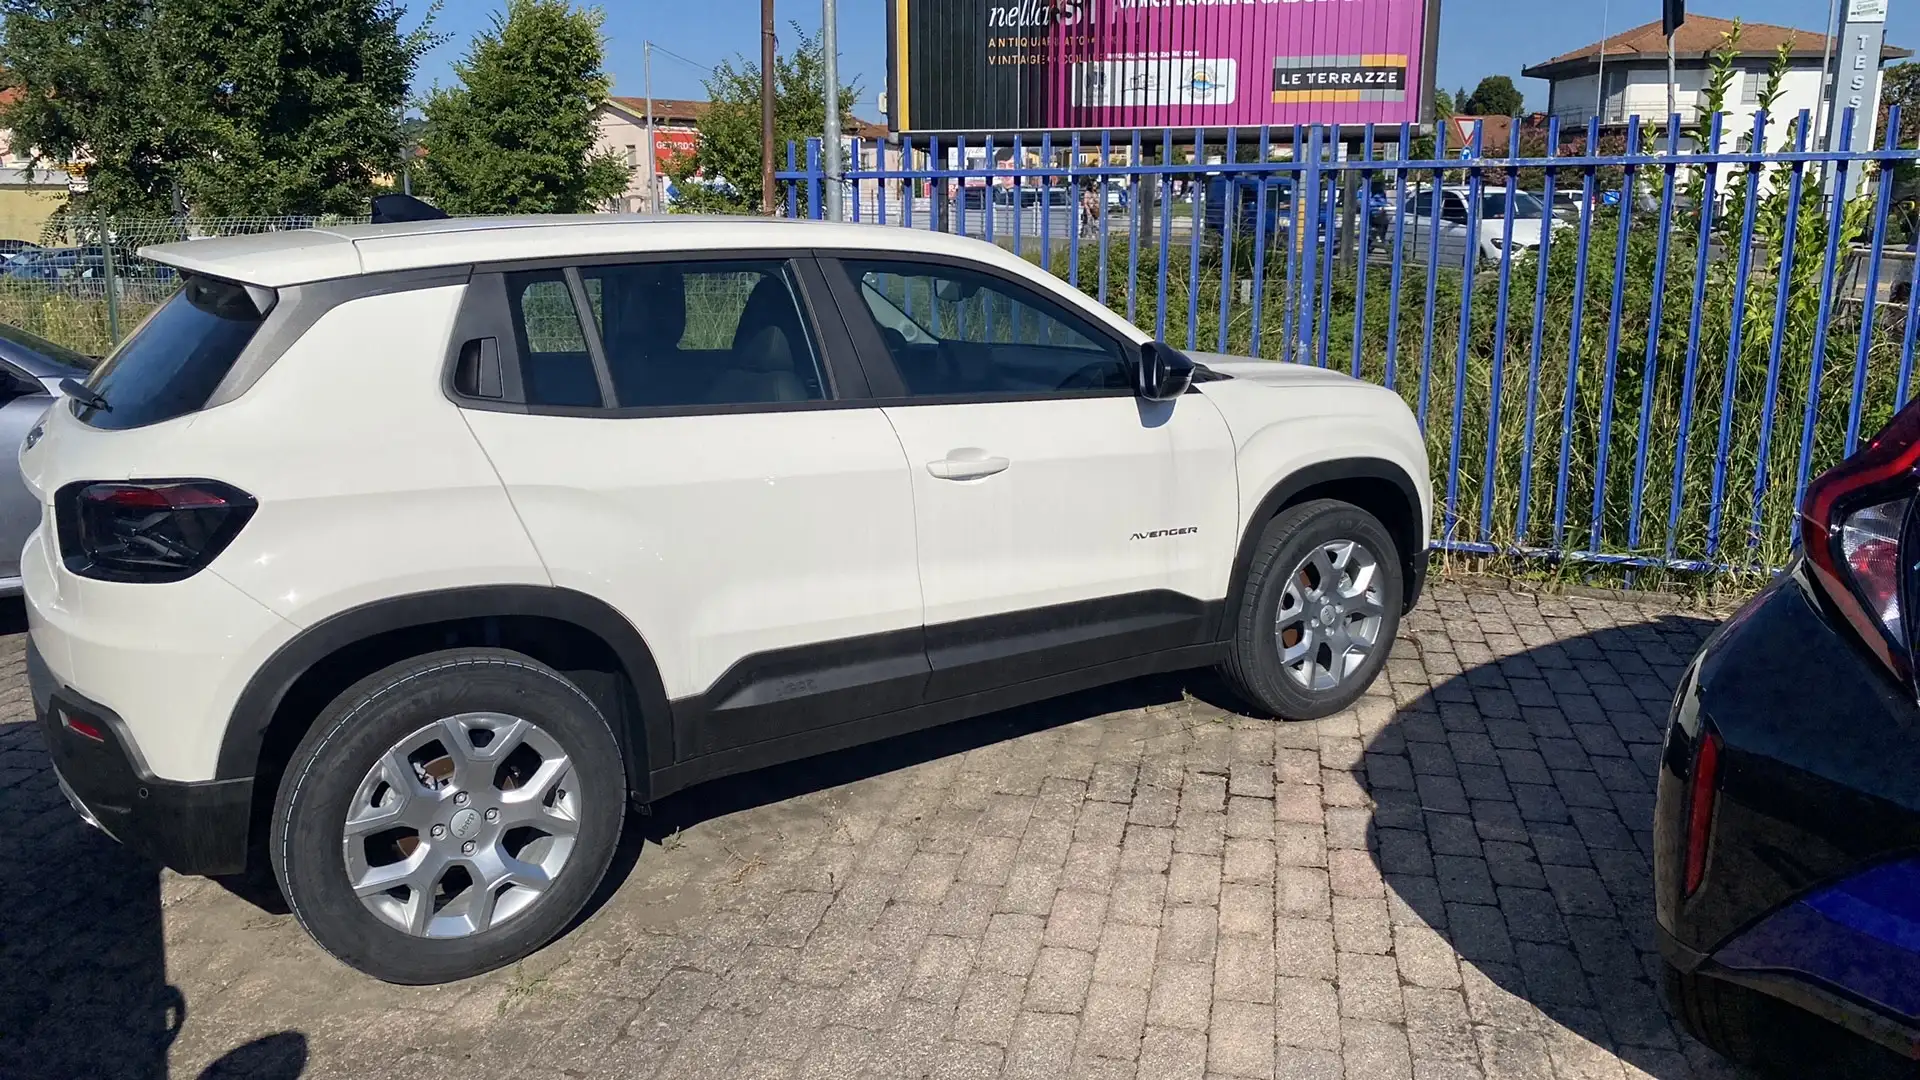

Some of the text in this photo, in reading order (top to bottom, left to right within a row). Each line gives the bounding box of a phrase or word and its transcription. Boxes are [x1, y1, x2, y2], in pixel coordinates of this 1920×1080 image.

[1281, 71, 1398, 85] LE TERRAZZE
[1129, 526, 1198, 541] AVENGER
[457, 812, 475, 836] Jeep
